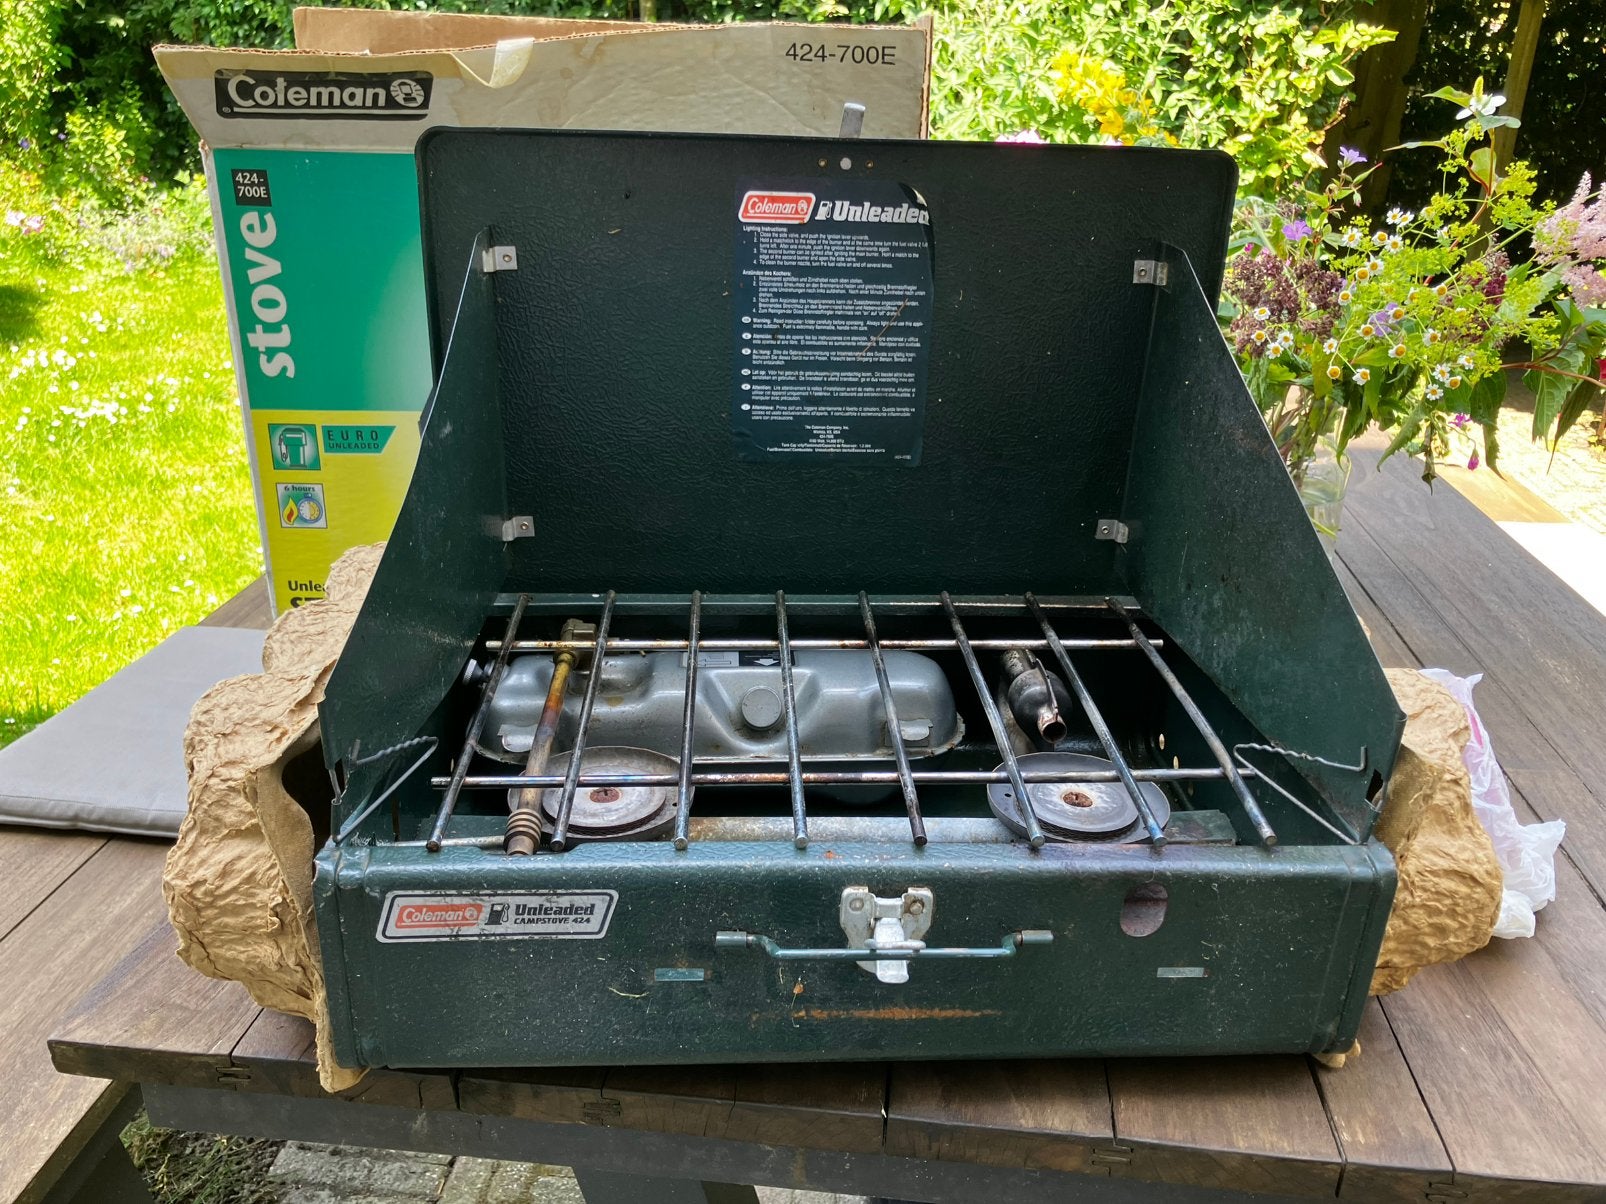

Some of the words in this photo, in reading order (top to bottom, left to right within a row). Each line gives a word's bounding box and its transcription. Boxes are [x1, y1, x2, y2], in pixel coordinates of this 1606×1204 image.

[785, 42, 897, 66] 424-700E
[227, 74, 387, 108] Coleman
[235, 172, 265, 185] 424-
[237, 185, 268, 198] 700E
[747, 197, 797, 214] Coleman
[832, 200, 930, 226] Unleaded
[240, 211, 296, 379] stove
[327, 429, 380, 442] EURO
[328, 442, 380, 450] UNLEADED
[284, 485, 290, 493] 6
[292, 485, 316, 493] hours
[288, 580, 326, 592] Unle
[402, 907, 464, 924] Coleman
[514, 903, 596, 916] Unleaded
[514, 917, 570, 925] CAMPSTOVE
[571, 916, 591, 924] 424
